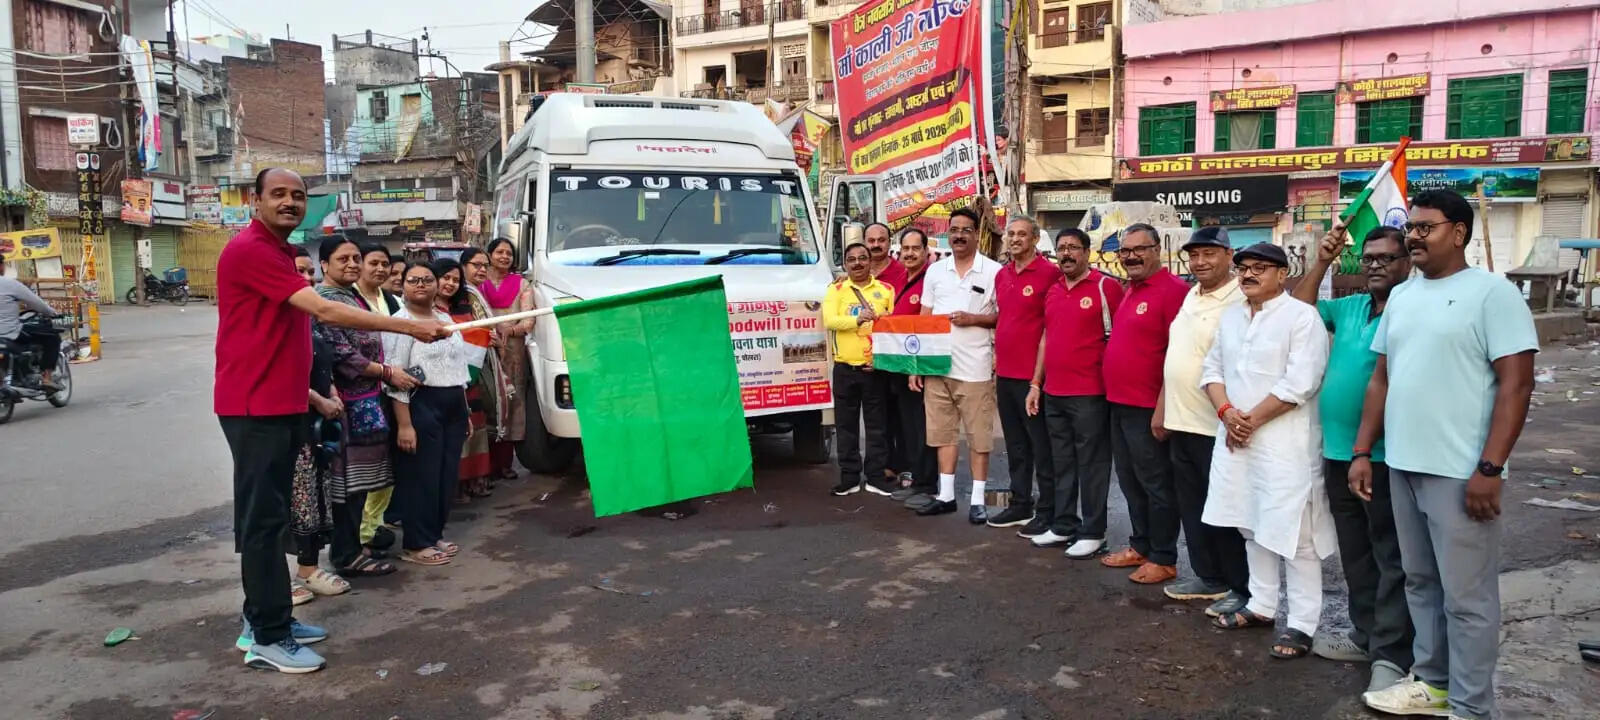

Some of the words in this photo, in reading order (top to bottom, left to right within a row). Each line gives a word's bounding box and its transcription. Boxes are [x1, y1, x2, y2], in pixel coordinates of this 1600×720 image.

[855, 26, 892, 67] काली
[896, 13, 914, 46] जी
[1353, 79, 1374, 91] कोठी
[910, 126, 923, 144] मार्च
[925, 123, 947, 140] 2026
[1140, 157, 1192, 173] कोठी
[1200, 152, 1338, 170] लालबहादुर
[1405, 144, 1489, 160] सर्राफ
[915, 161, 929, 182] मार्च
[557, 176, 796, 194] TOURIST
[1156, 189, 1242, 206] SAMSUNG
[730, 317, 780, 332] oodwill
[785, 317, 817, 329] Tour
[756, 337, 778, 348] यात्रा
